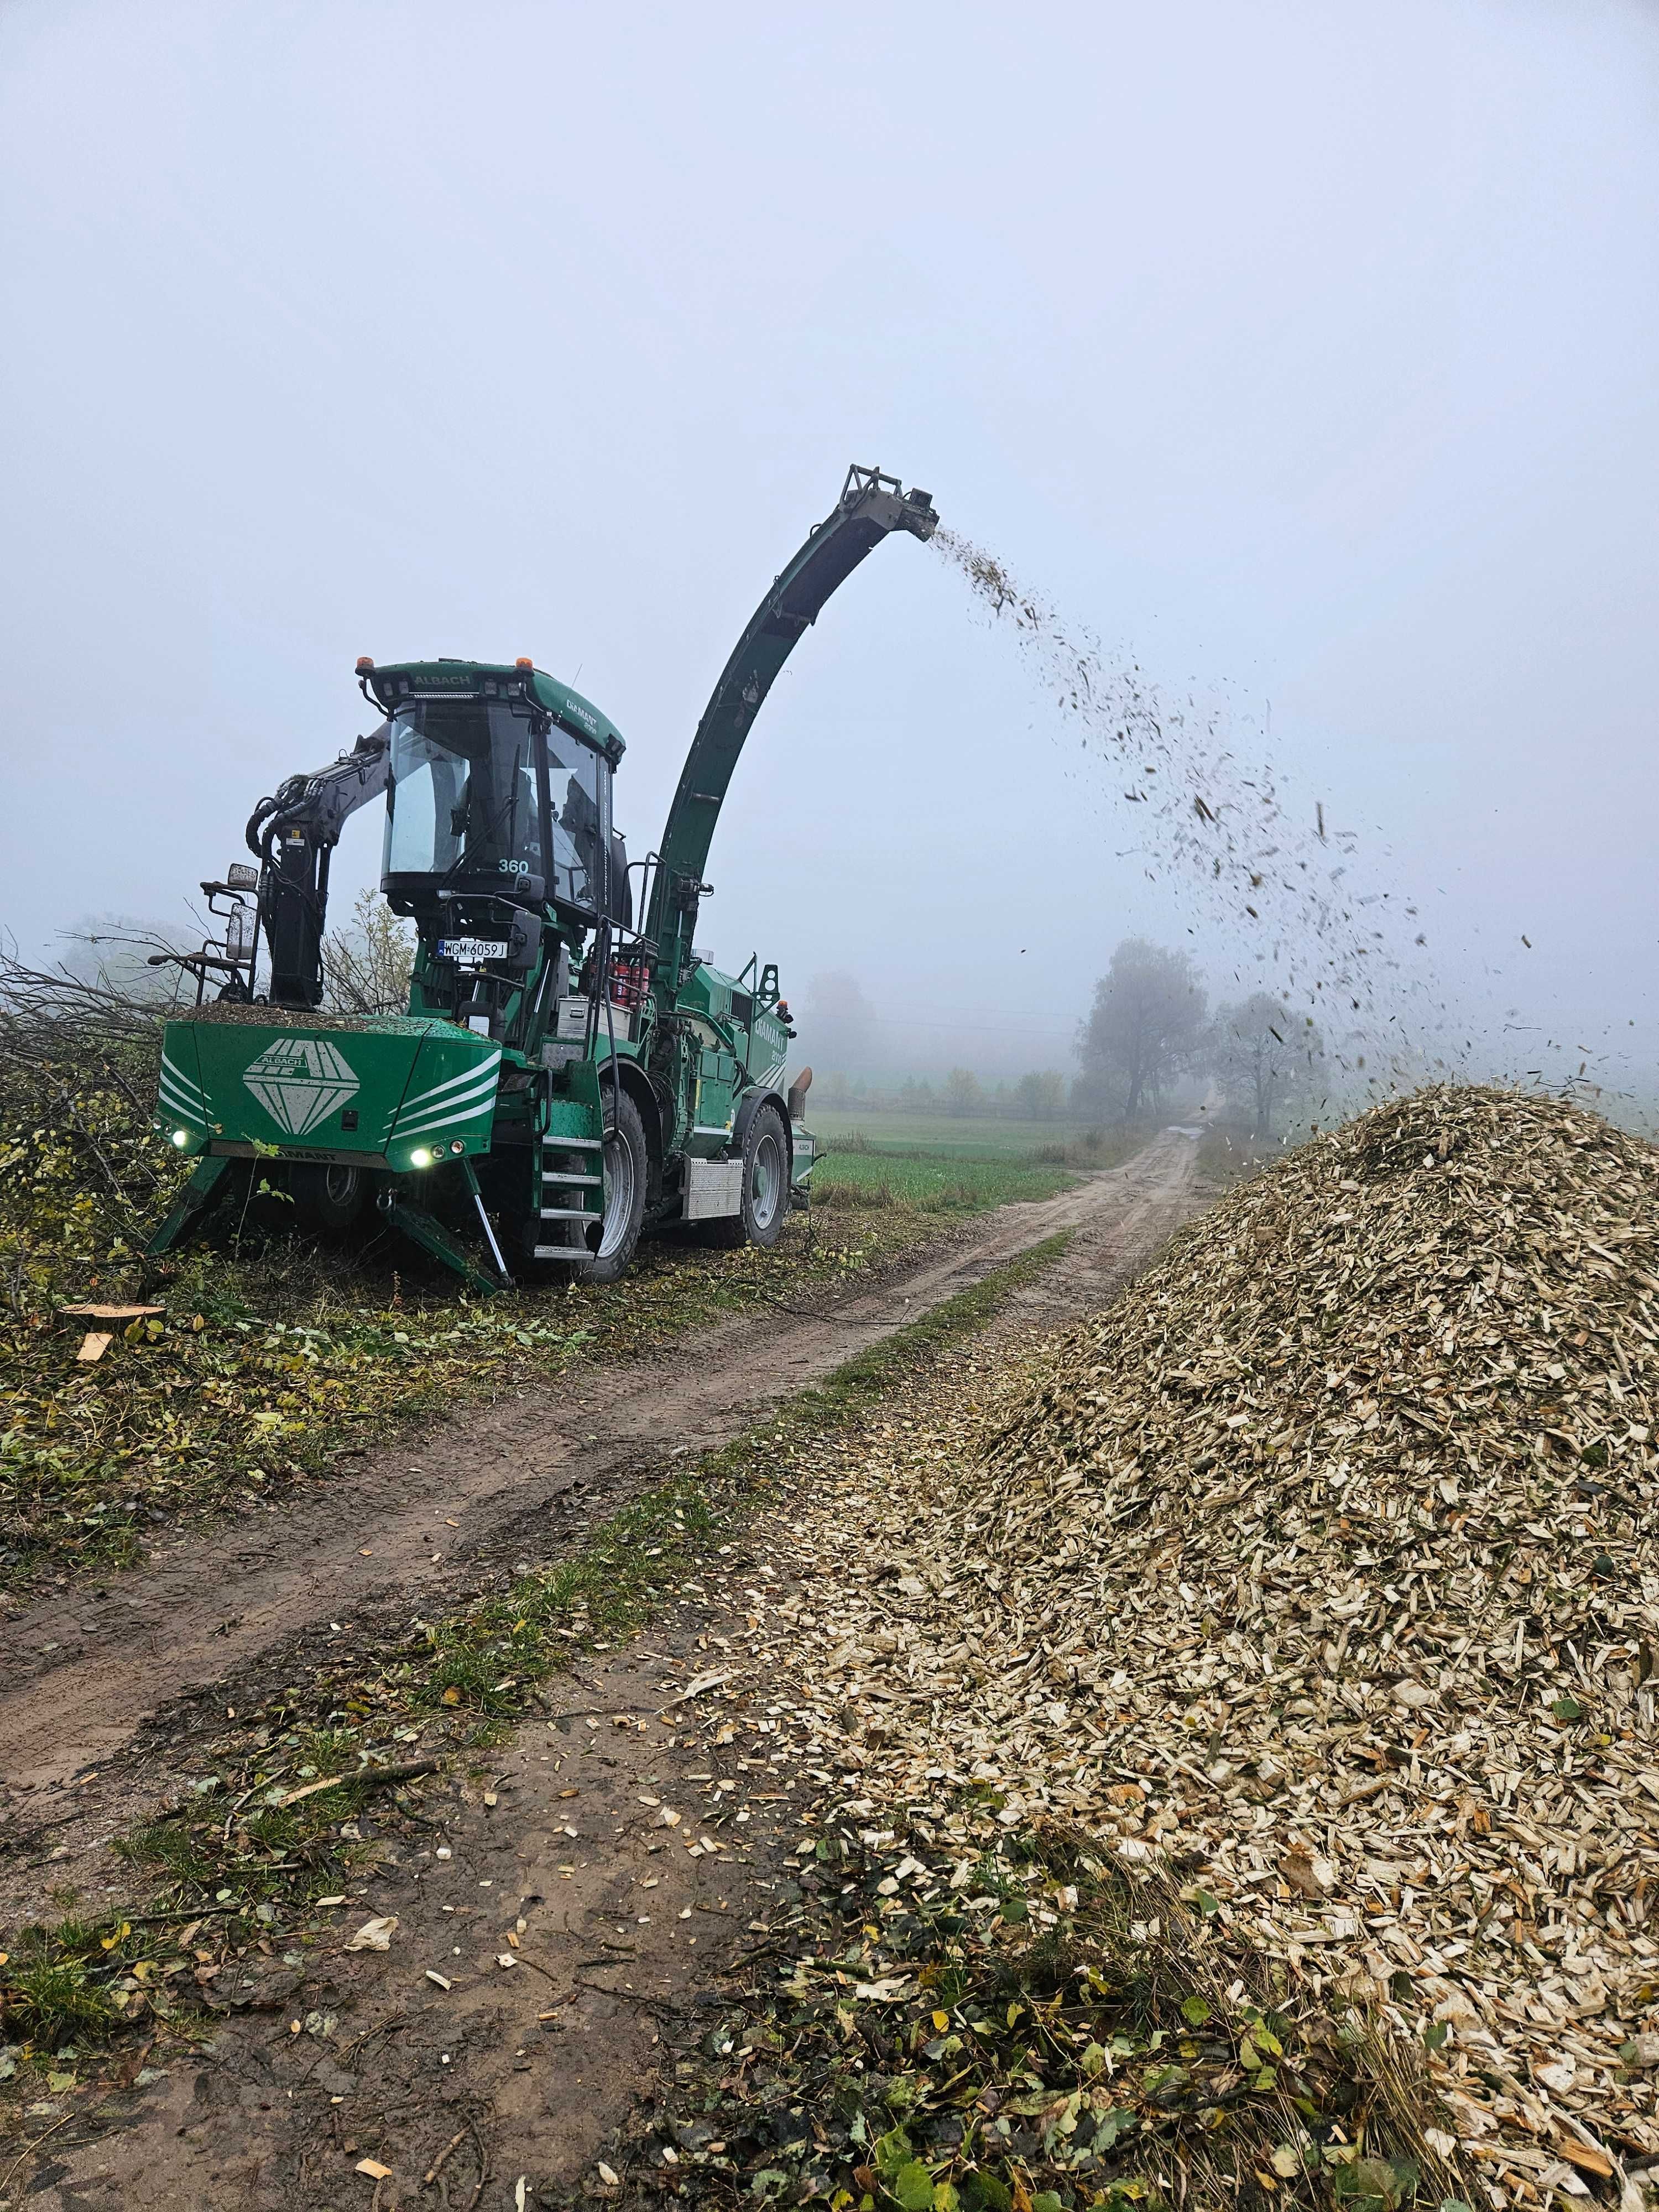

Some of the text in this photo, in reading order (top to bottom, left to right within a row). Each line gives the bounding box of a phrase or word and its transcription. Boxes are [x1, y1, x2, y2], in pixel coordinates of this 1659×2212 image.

[415, 676, 471, 685] ALBACH
[499, 859, 529, 874] 360
[445, 942, 504, 957] WGM 6059J
[262, 1057, 301, 1065] ALBACH
